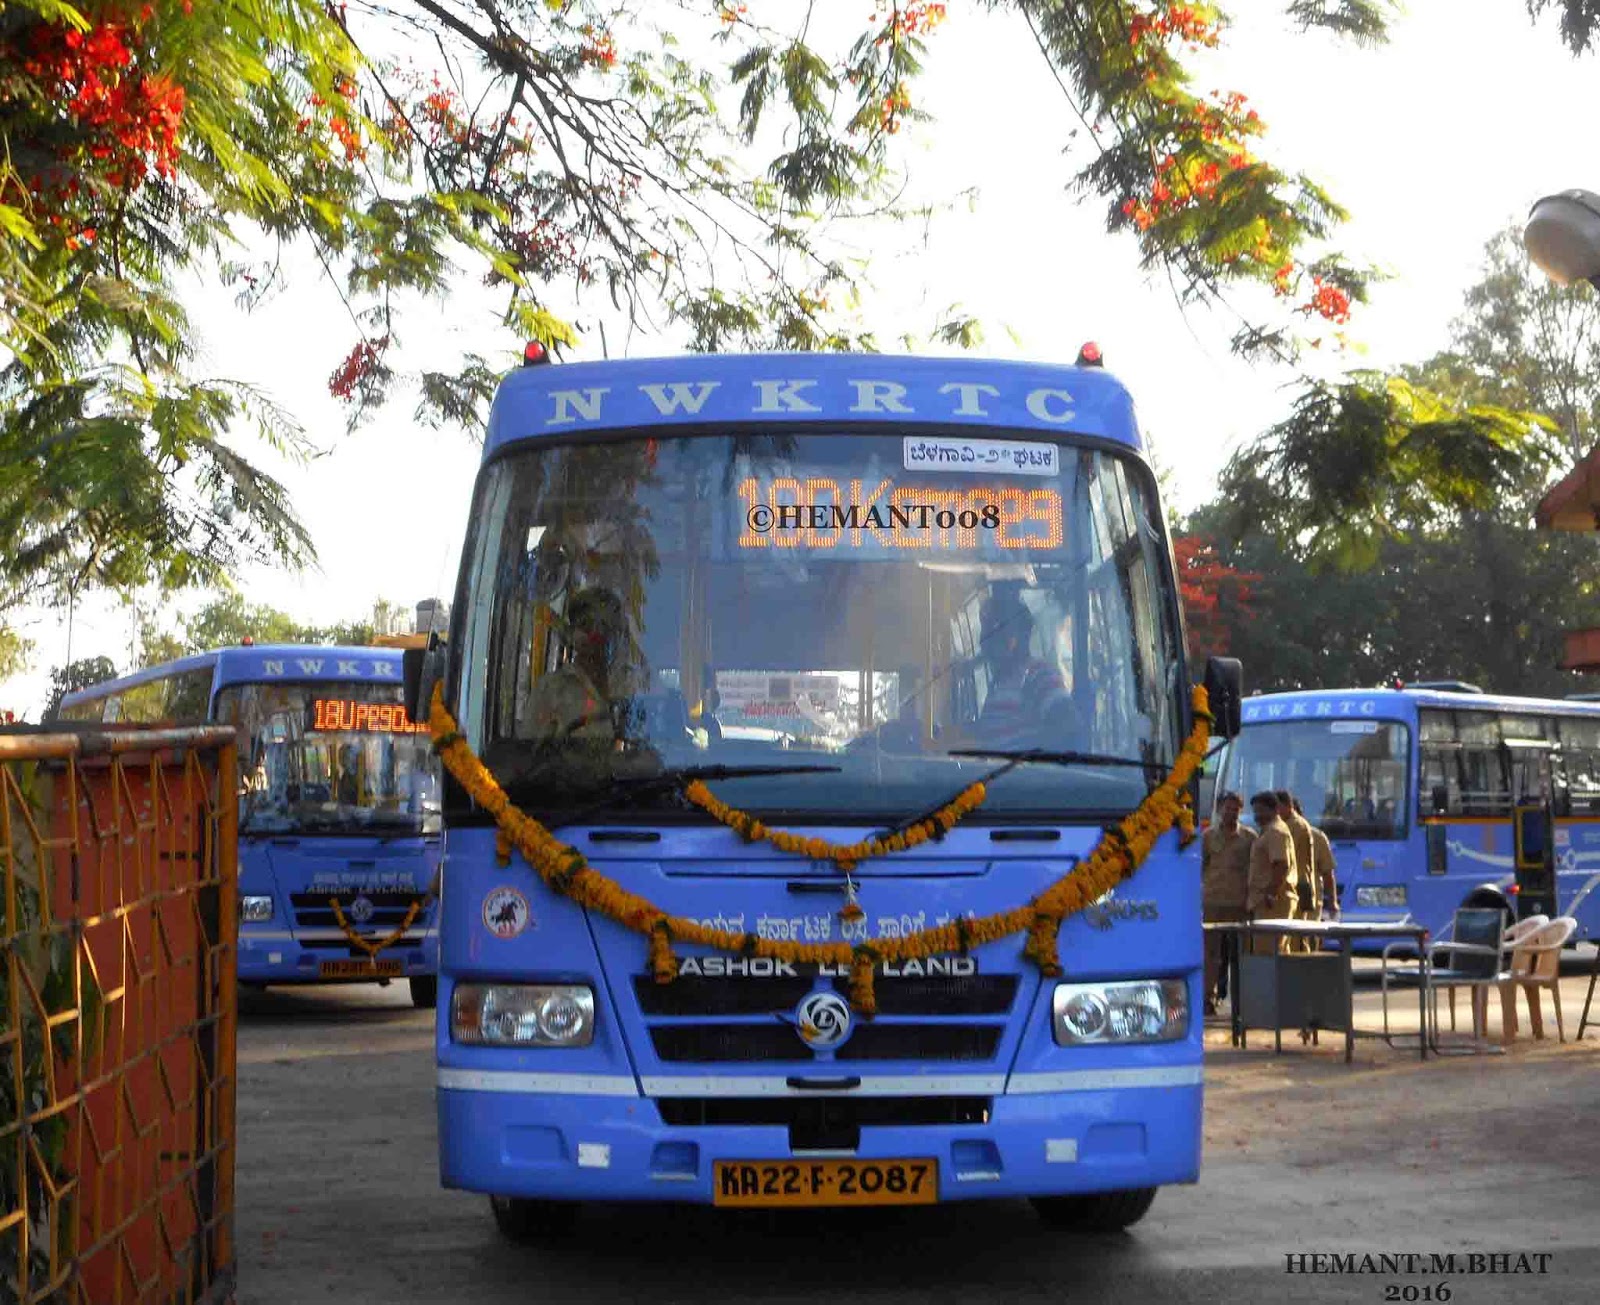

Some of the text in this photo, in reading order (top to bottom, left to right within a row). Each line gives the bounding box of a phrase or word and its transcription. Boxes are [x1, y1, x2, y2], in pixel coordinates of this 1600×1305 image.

[546, 379, 1076, 425] NWKRTC
[262, 659, 394, 676] NWKR
[678, 956, 976, 977] ASHOK LLAND
